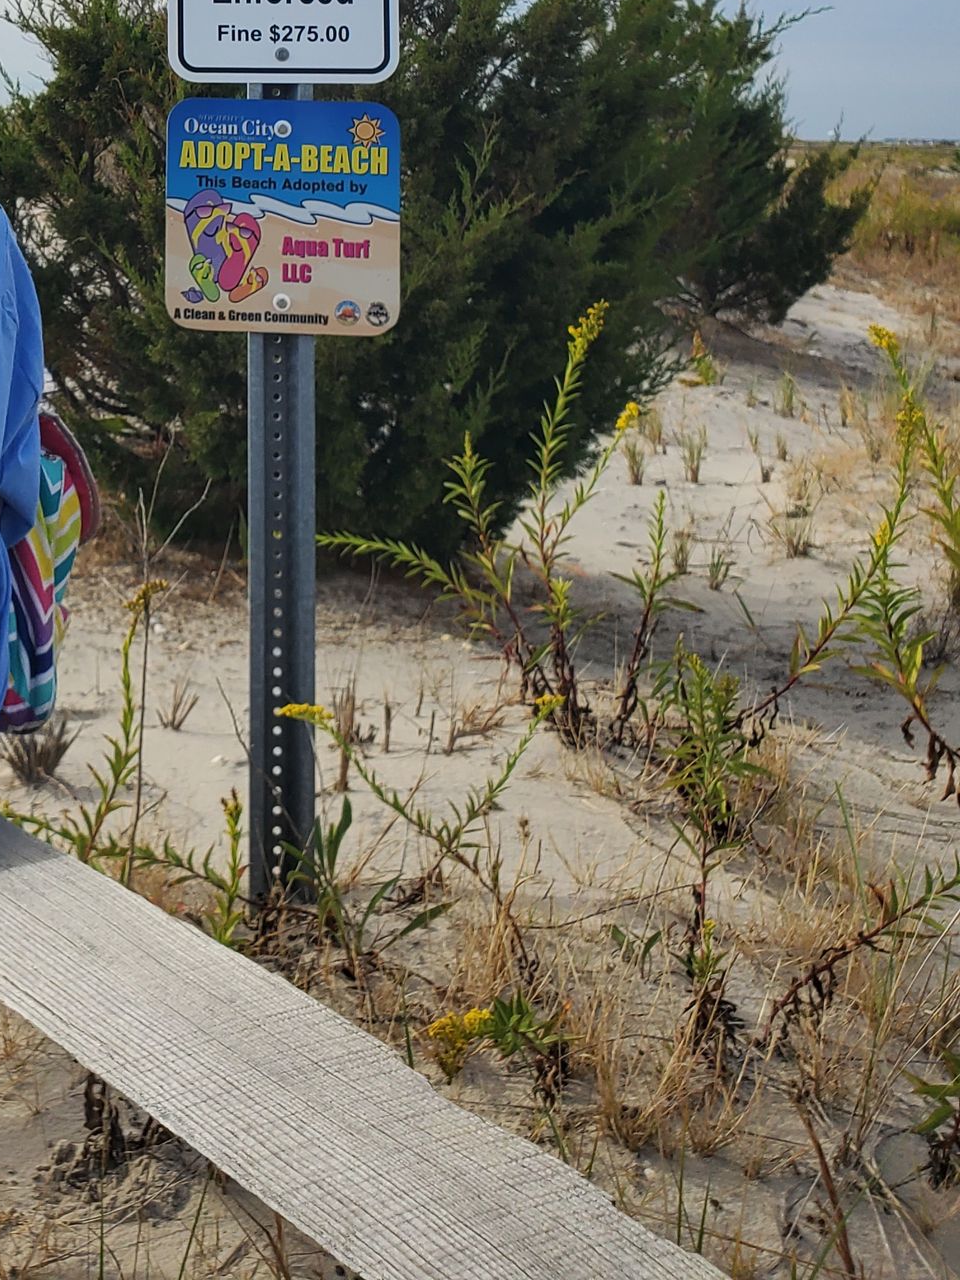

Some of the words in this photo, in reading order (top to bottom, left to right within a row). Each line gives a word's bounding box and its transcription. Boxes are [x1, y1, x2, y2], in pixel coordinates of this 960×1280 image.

[217, 24, 262, 42] Fine
[269, 23, 351, 44] $275.00
[183, 117, 238, 136] Ocean
[241, 119, 277, 141] City
[179, 140, 389, 176] ADOPT-A-BEACH
[196, 174, 227, 189] This
[231, 176, 277, 191] Beach
[281, 178, 344, 194] Adopted
[349, 179, 368, 195] by
[281, 236, 329, 258] Aqua
[332, 238, 371, 259] Turf
[281, 263, 313, 284] LLC
[173, 308, 182, 319] A
[183, 308, 216, 321] Clean
[218, 310, 226, 321] &
[228, 310, 262, 322] Green
[264, 311, 329, 325] Community
